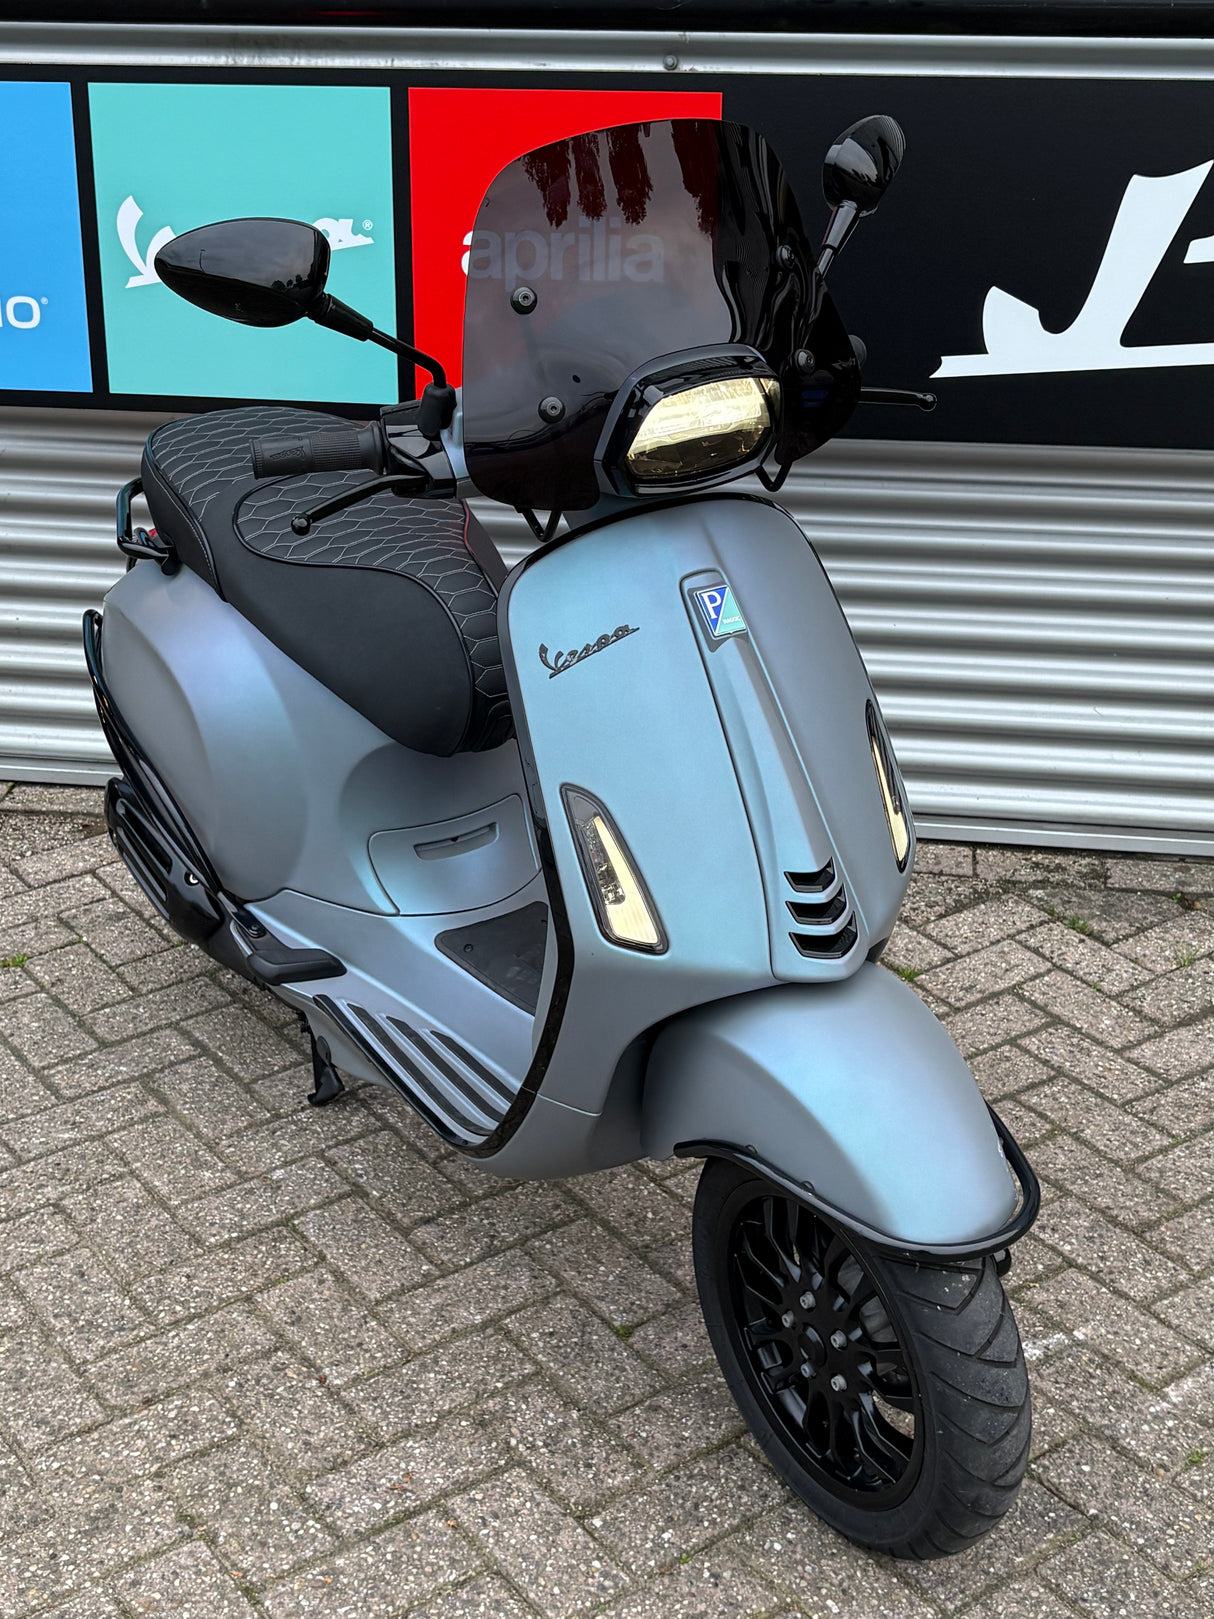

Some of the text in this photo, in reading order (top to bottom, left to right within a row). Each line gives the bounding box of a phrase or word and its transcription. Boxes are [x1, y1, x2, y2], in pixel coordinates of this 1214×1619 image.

[461, 216, 665, 292] aprilia
[701, 591, 722, 619] P
[539, 624, 640, 679] Vespa
